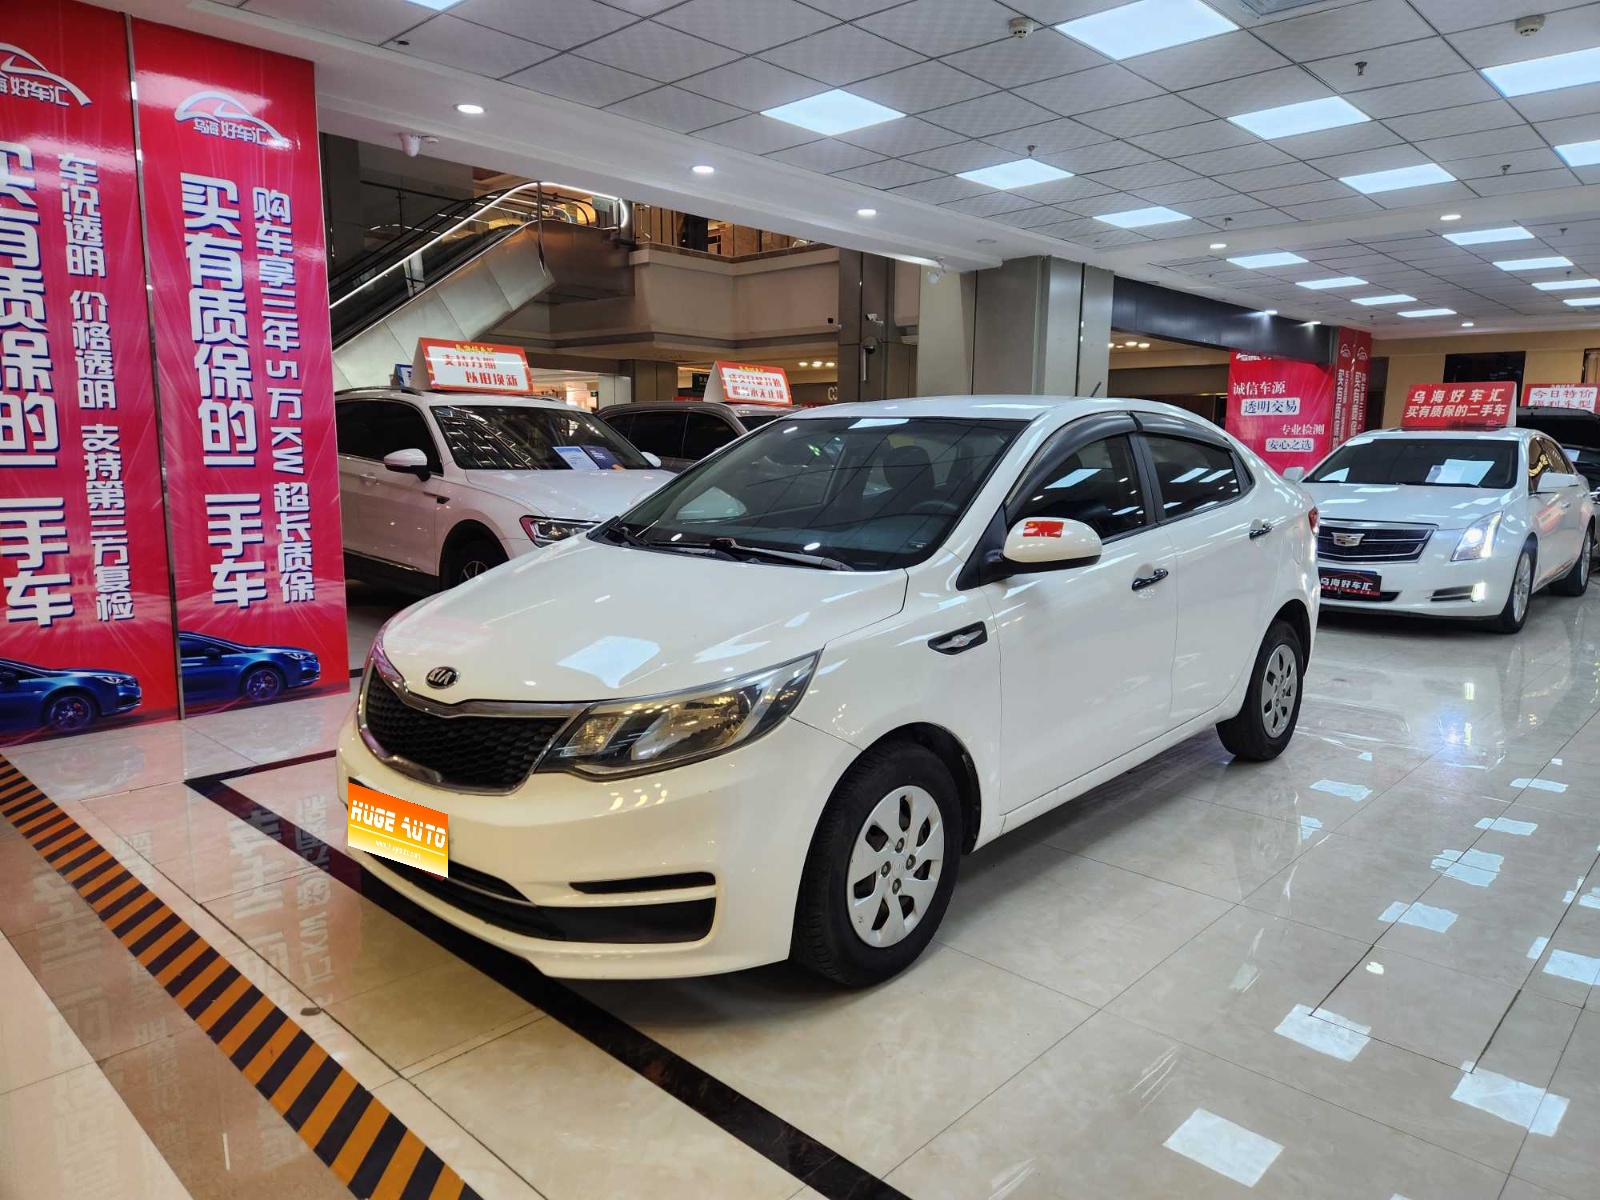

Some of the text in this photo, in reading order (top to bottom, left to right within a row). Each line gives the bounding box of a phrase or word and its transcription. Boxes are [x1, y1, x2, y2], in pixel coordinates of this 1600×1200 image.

[193, 118, 268, 146] 乌海好车汇
[465, 371, 519, 387] 以旧换新
[58, 153, 134, 621] 车况透明 价格透明 支持第三方复检
[180, 172, 267, 607] 买有质保的二手车
[1233, 381, 1286, 395] 诚信车源
[1533, 389, 1594, 398] 今日特价
[1411, 388, 1505, 403] 乌海好车汇
[1244, 400, 1297, 414] 透明交易
[1405, 404, 1508, 418] 买有质保的二手车
[1281, 424, 1325, 435] 专业检测
[1268, 439, 1312, 450] 安心之选
[1320, 577, 1374, 591] 乌海好车汇
[427, 668, 454, 685] KIA
